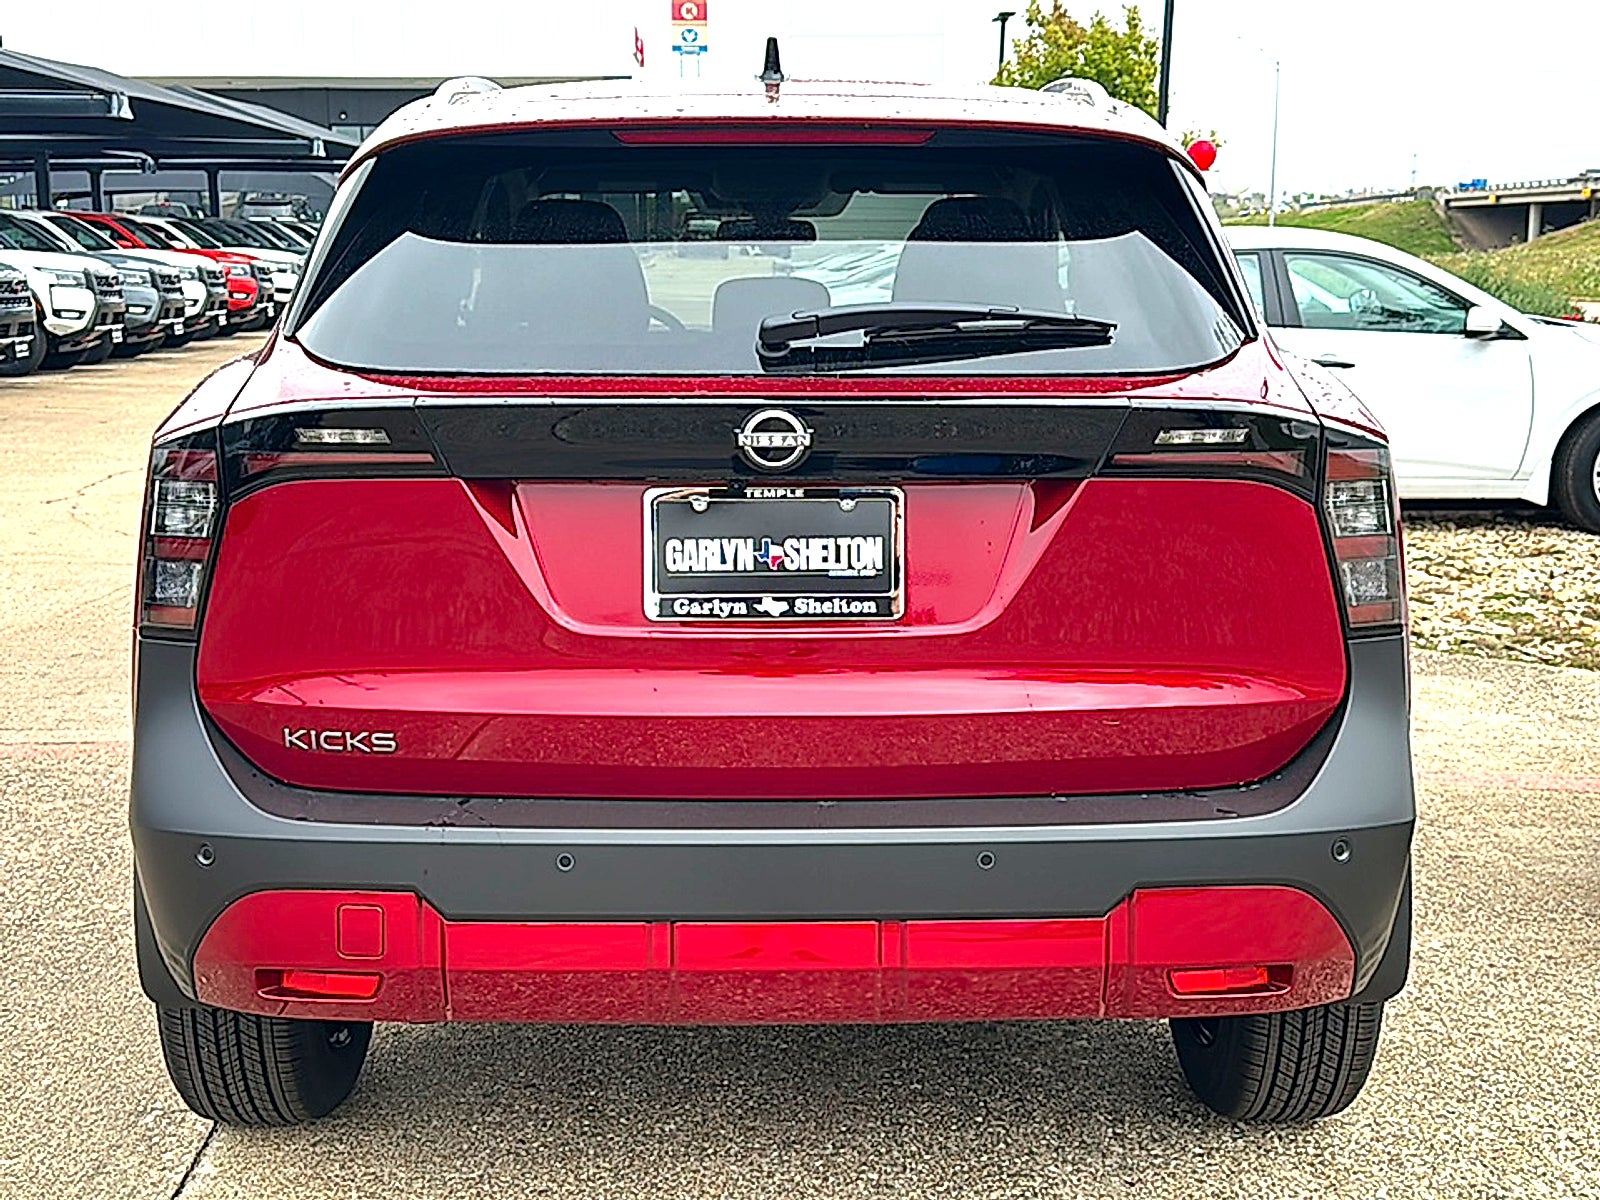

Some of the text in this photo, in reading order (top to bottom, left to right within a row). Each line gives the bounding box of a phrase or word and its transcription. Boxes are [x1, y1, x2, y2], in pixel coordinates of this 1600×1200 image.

[738, 433, 811, 448] NISSAN
[744, 488, 805, 498] TEMPLE
[665, 536, 883, 572] GARLYN SHELTON
[673, 597, 878, 617] Garlyn Shelton
[283, 727, 397, 753] KICKS
